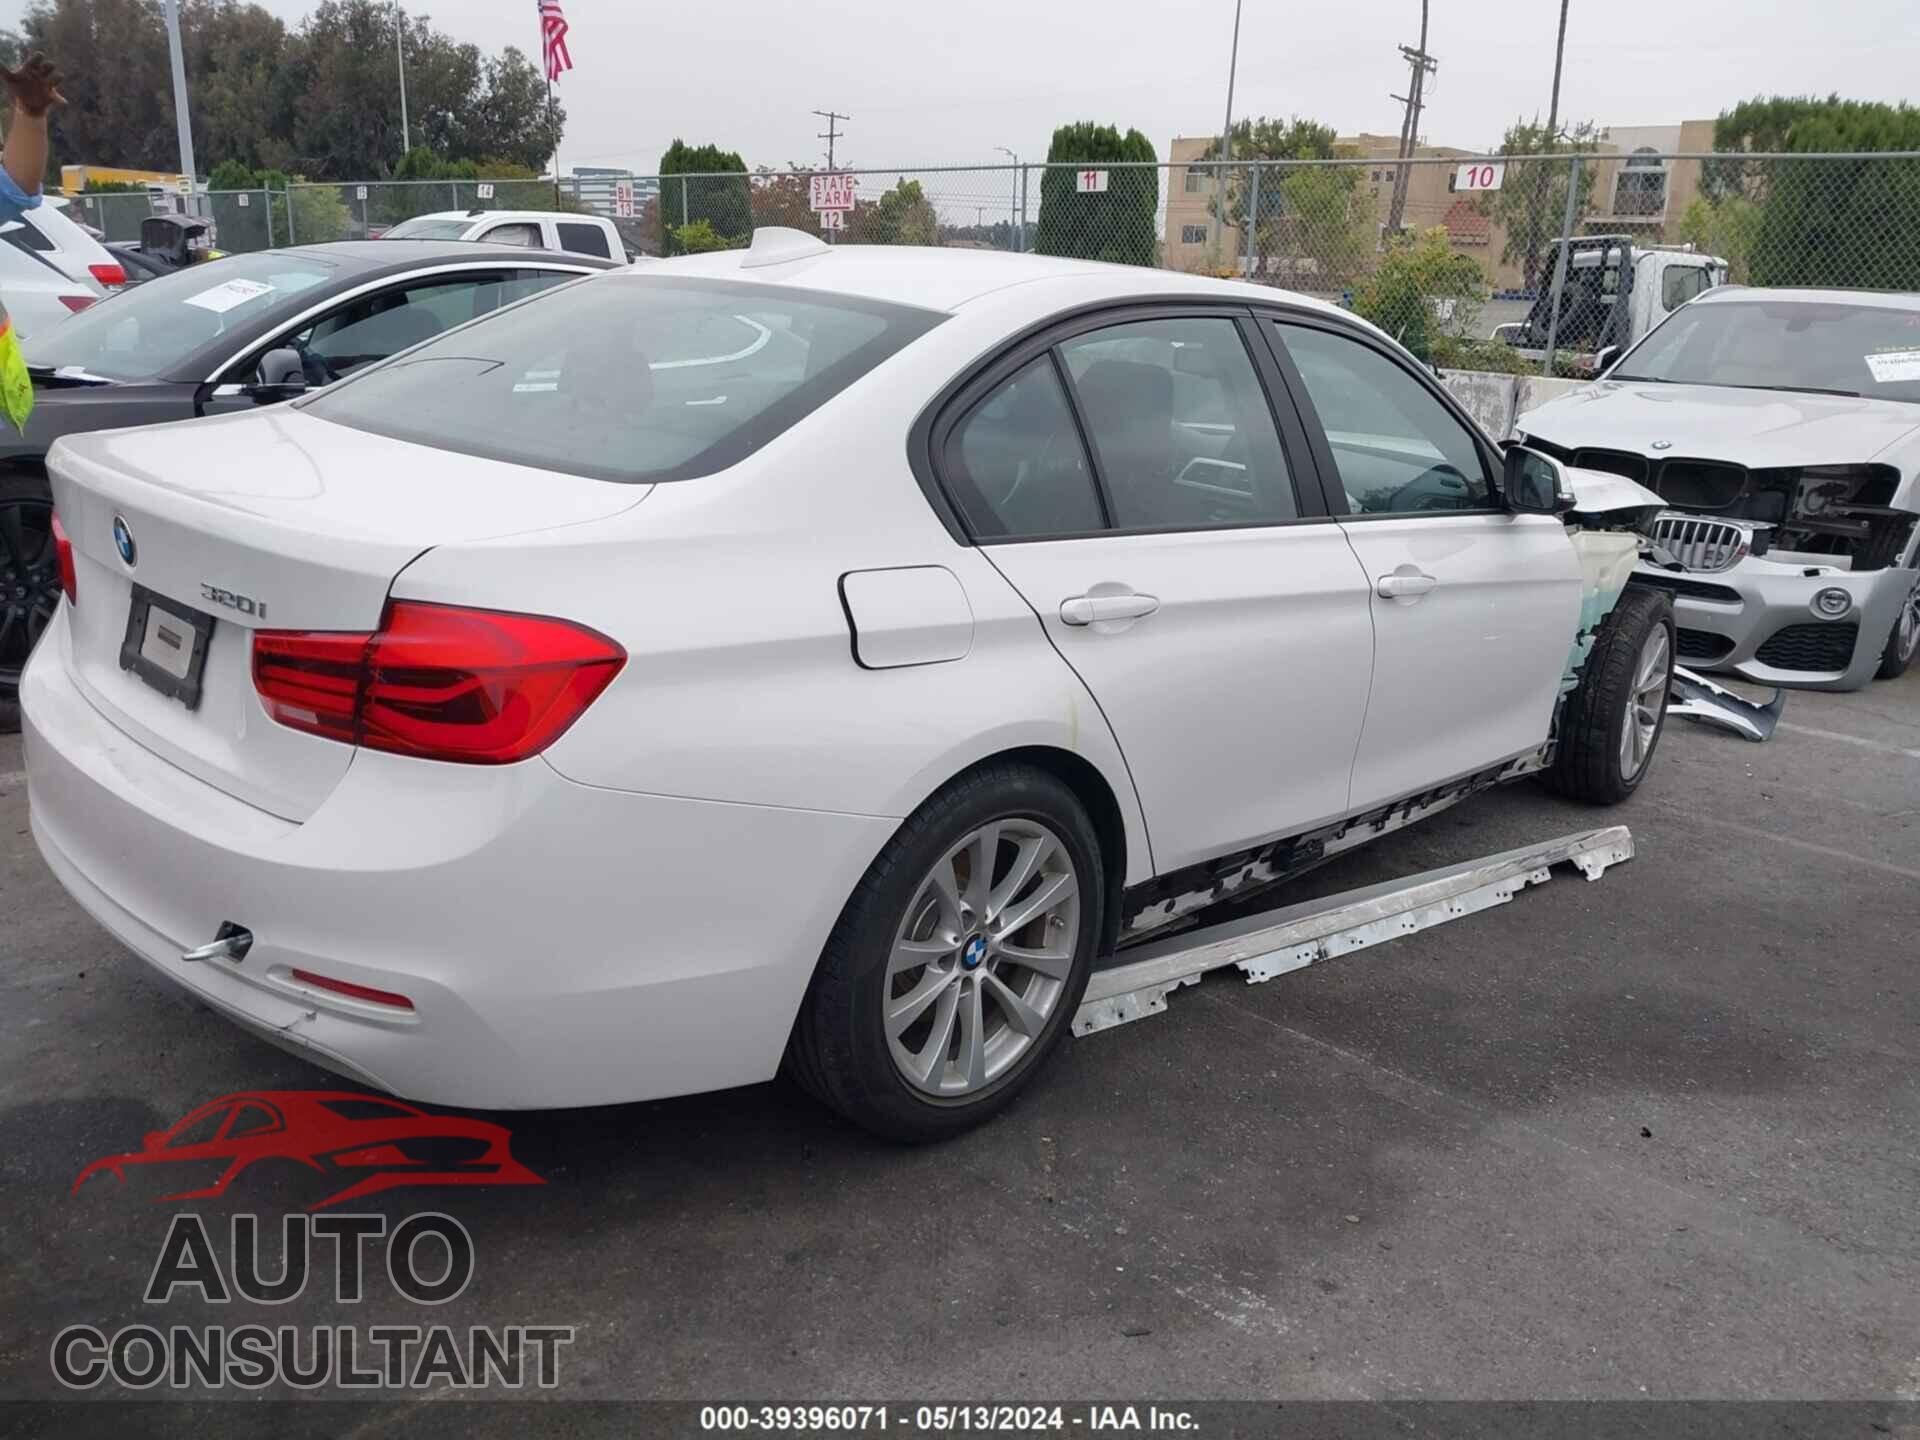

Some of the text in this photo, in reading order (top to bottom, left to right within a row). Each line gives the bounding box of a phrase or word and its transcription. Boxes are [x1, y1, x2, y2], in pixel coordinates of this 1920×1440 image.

[814, 175, 853, 191] STATE
[1083, 172, 1096, 190] 11
[1467, 166, 1494, 188] 10
[815, 191, 852, 205] FARM
[620, 202, 631, 216] 13
[824, 211, 840, 228] 12
[200, 582, 267, 620] 320i
